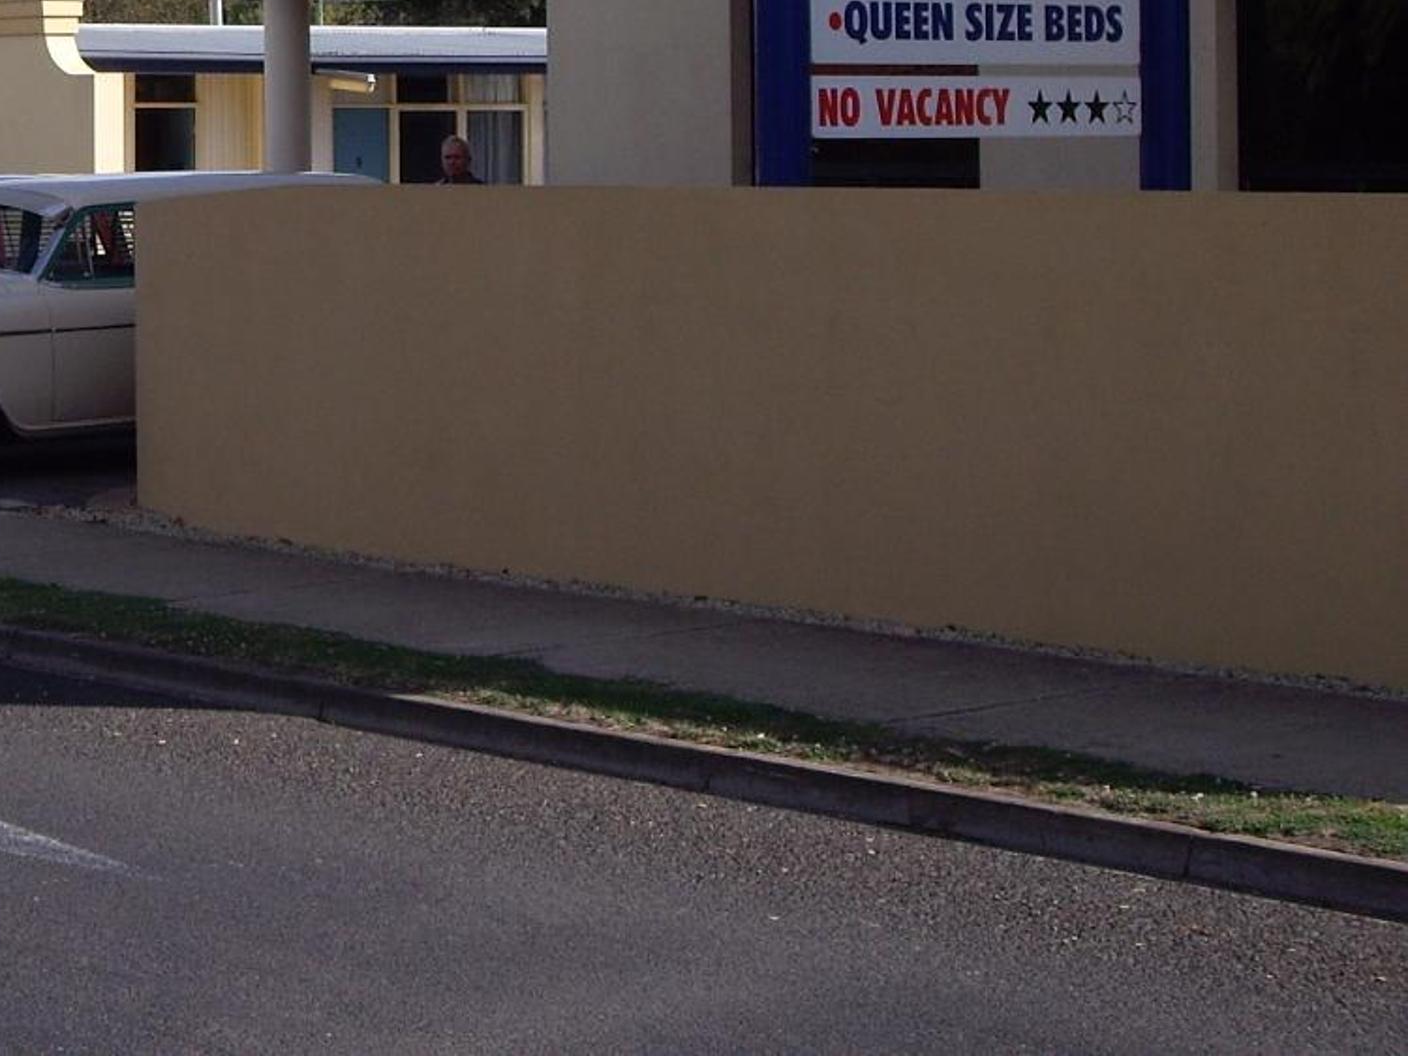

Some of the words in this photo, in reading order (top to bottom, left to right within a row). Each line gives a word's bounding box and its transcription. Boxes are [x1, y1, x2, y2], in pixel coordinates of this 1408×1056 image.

[844, 0, 954, 45] QUEEN
[965, 3, 1032, 42] SIZE
[1045, 5, 1123, 43] BEDS
[818, 87, 859, 127] NO
[876, 87, 1010, 126] VACANCY
